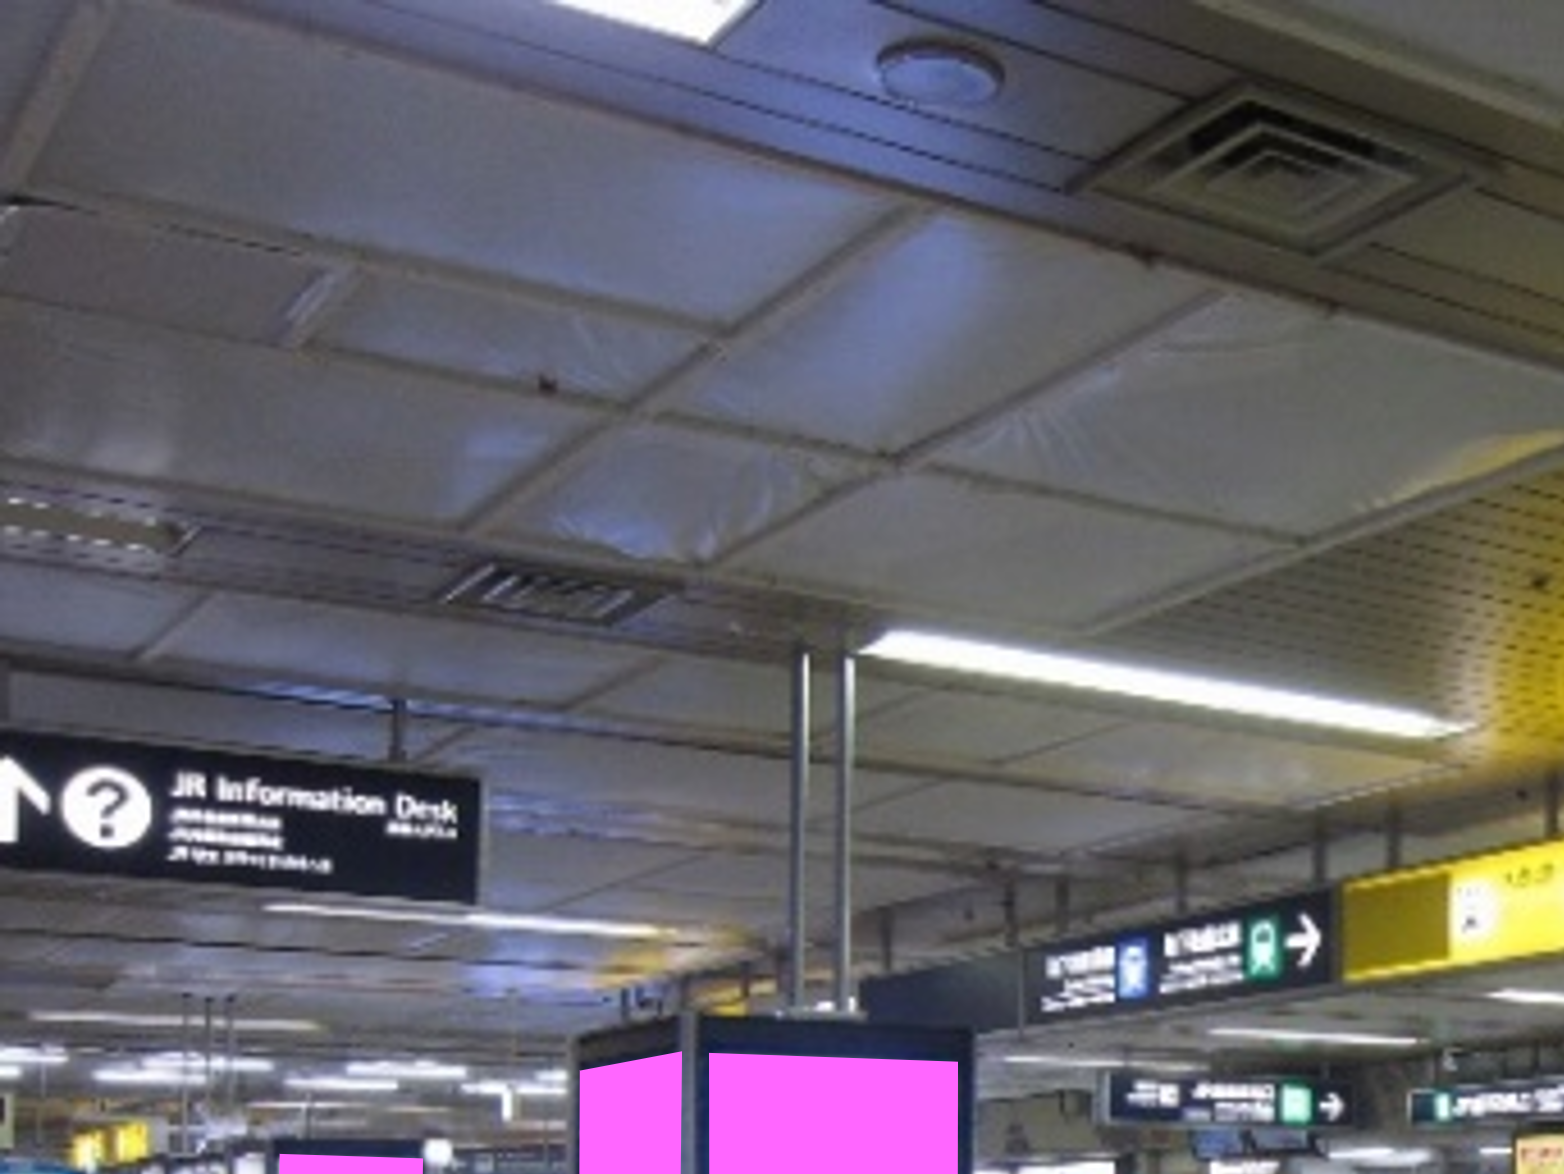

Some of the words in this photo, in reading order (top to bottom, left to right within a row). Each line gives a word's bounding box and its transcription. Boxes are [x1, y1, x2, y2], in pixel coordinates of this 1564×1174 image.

[170, 771, 206, 798] JR
[216, 776, 387, 816] Information
[395, 792, 458, 824] Desk
